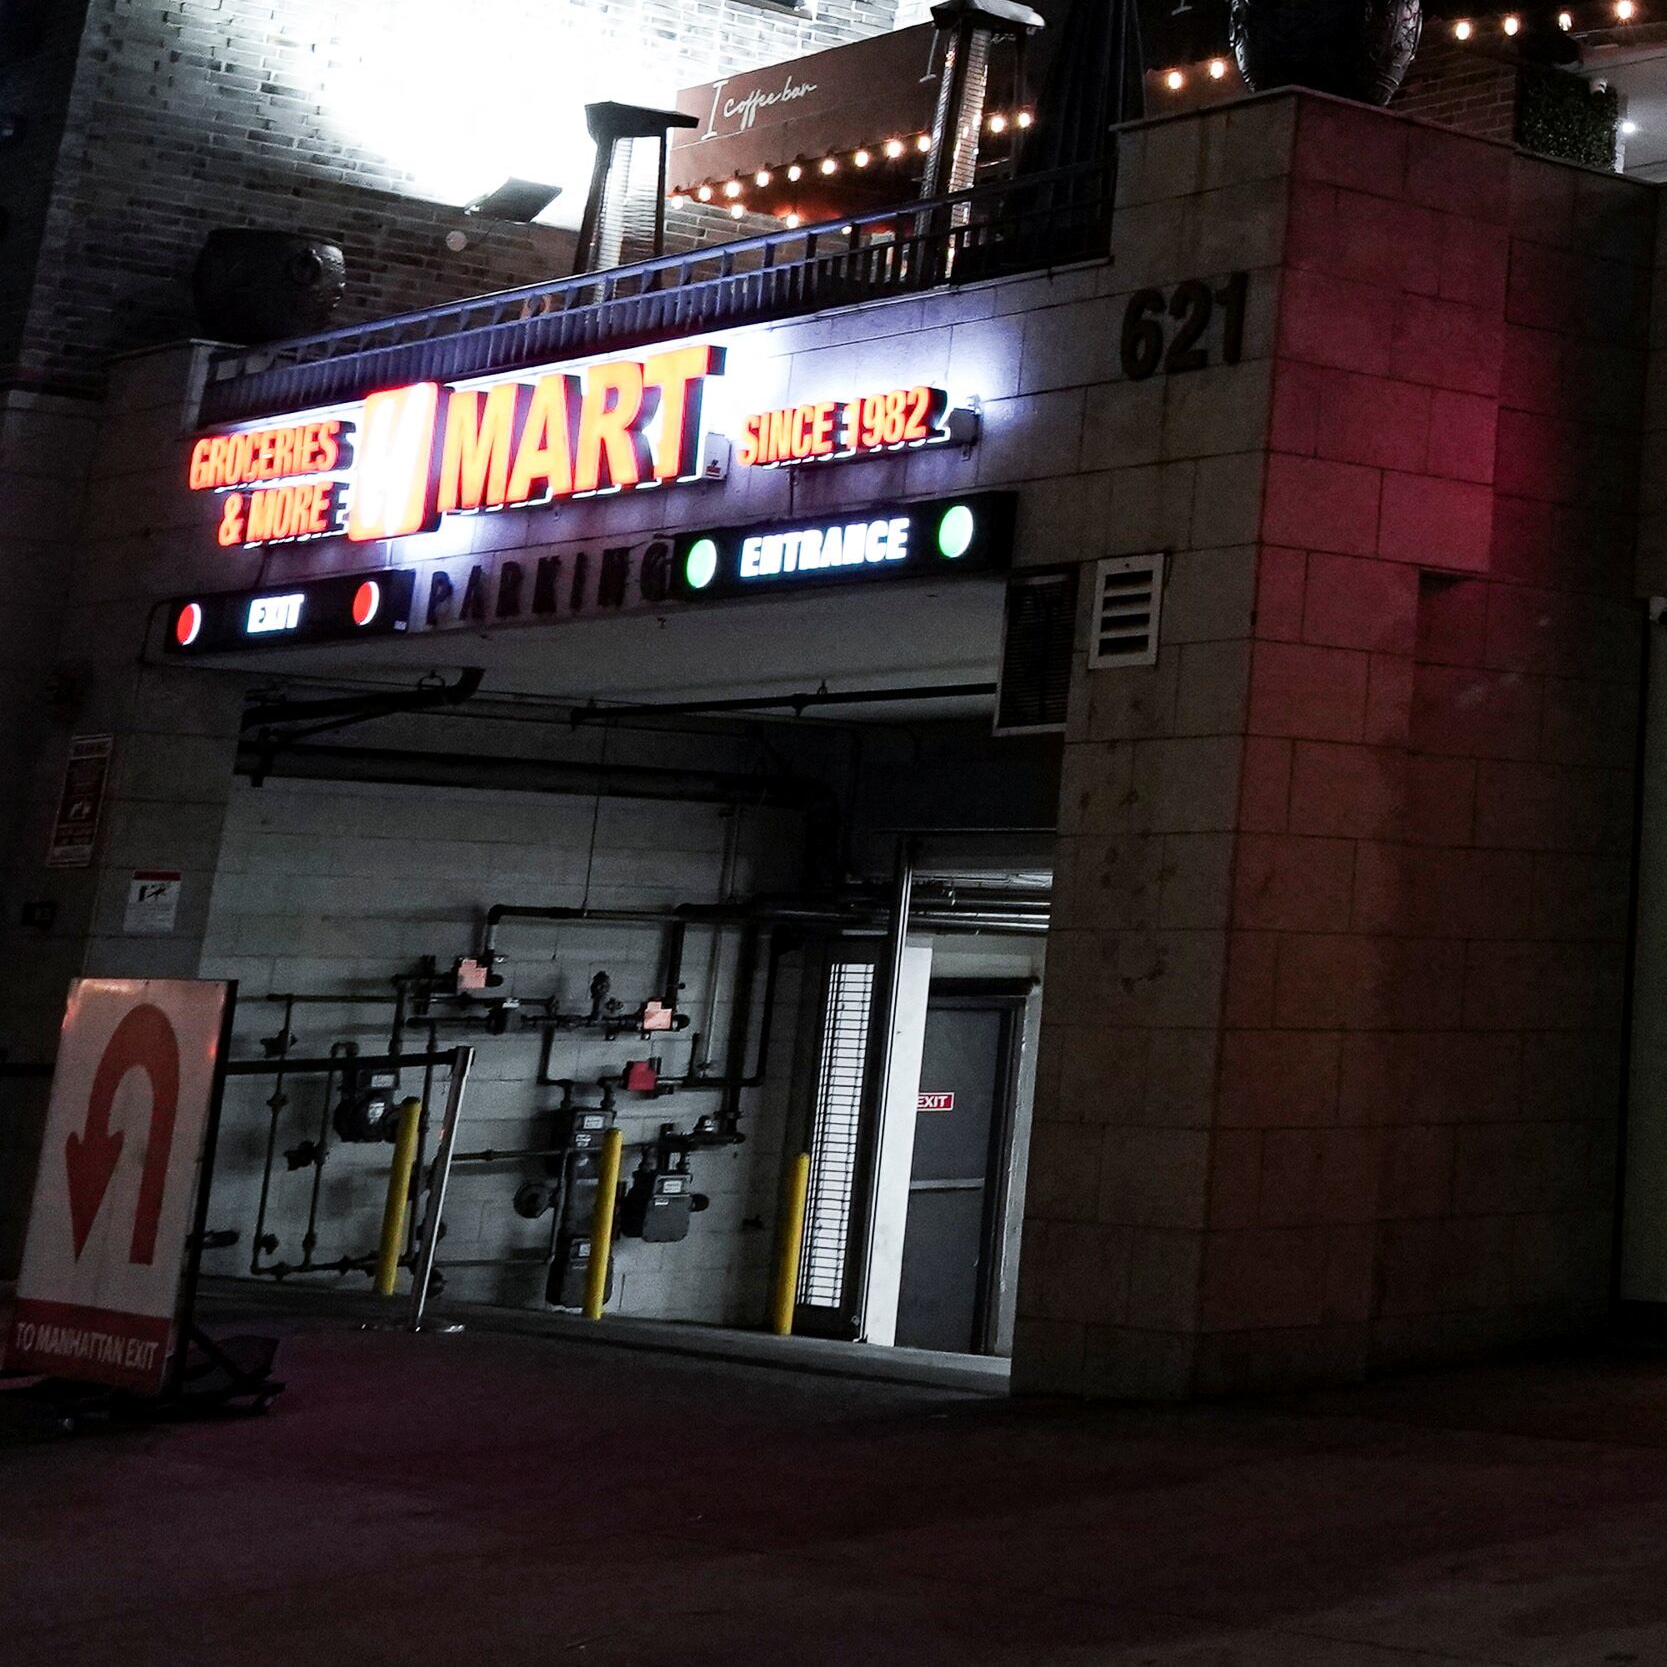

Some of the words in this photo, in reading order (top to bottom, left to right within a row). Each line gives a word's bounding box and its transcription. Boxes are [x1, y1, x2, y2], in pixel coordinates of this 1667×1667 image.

[1121, 271, 1249, 382] 621
[189, 420, 341, 490] GROCERIES
[437, 344, 709, 513] MART
[737, 401, 836, 465] SINCE
[842, 386, 931, 449] 1982
[218, 492, 244, 547] &
[246, 481, 334, 542] MORE
[740, 517, 911, 578] ENTRANCE
[247, 593, 305, 633] EXIT
[426, 540, 675, 625] PARKING
[918, 1095, 949, 1108] EXIT
[16, 1322, 36, 1351] TO
[35, 1324, 126, 1364] MANHATTAN
[125, 1337, 159, 1370] EXIT
